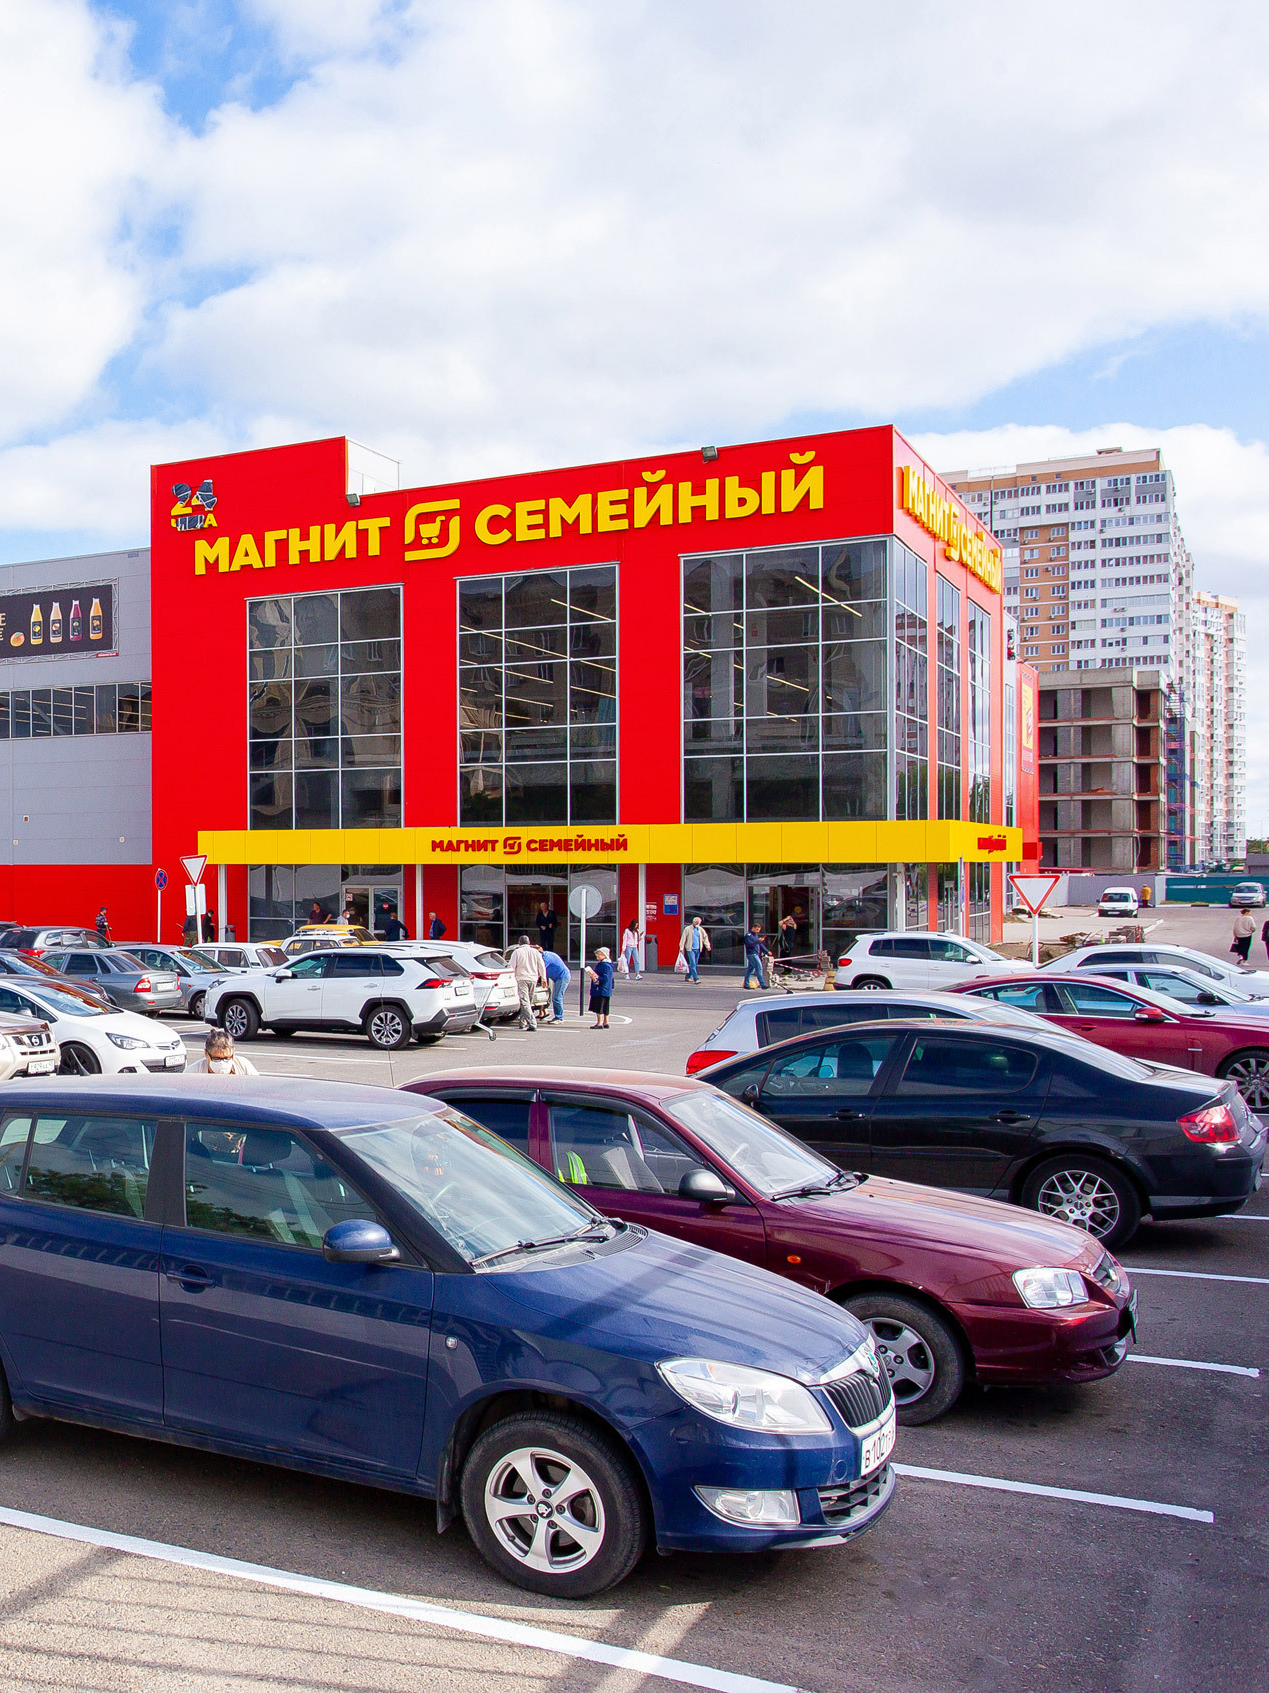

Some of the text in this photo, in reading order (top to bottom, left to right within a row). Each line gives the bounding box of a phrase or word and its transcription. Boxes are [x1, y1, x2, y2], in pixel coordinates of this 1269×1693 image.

[194, 451, 825, 576] МАГНИТ СЕМЕЙНЫЙ
[903, 465, 1001, 594] МАГНИТ СЕМЕЙНЫЙ
[431, 834, 628, 852] МАГНИТ СЕМЕЙНЫЙ
